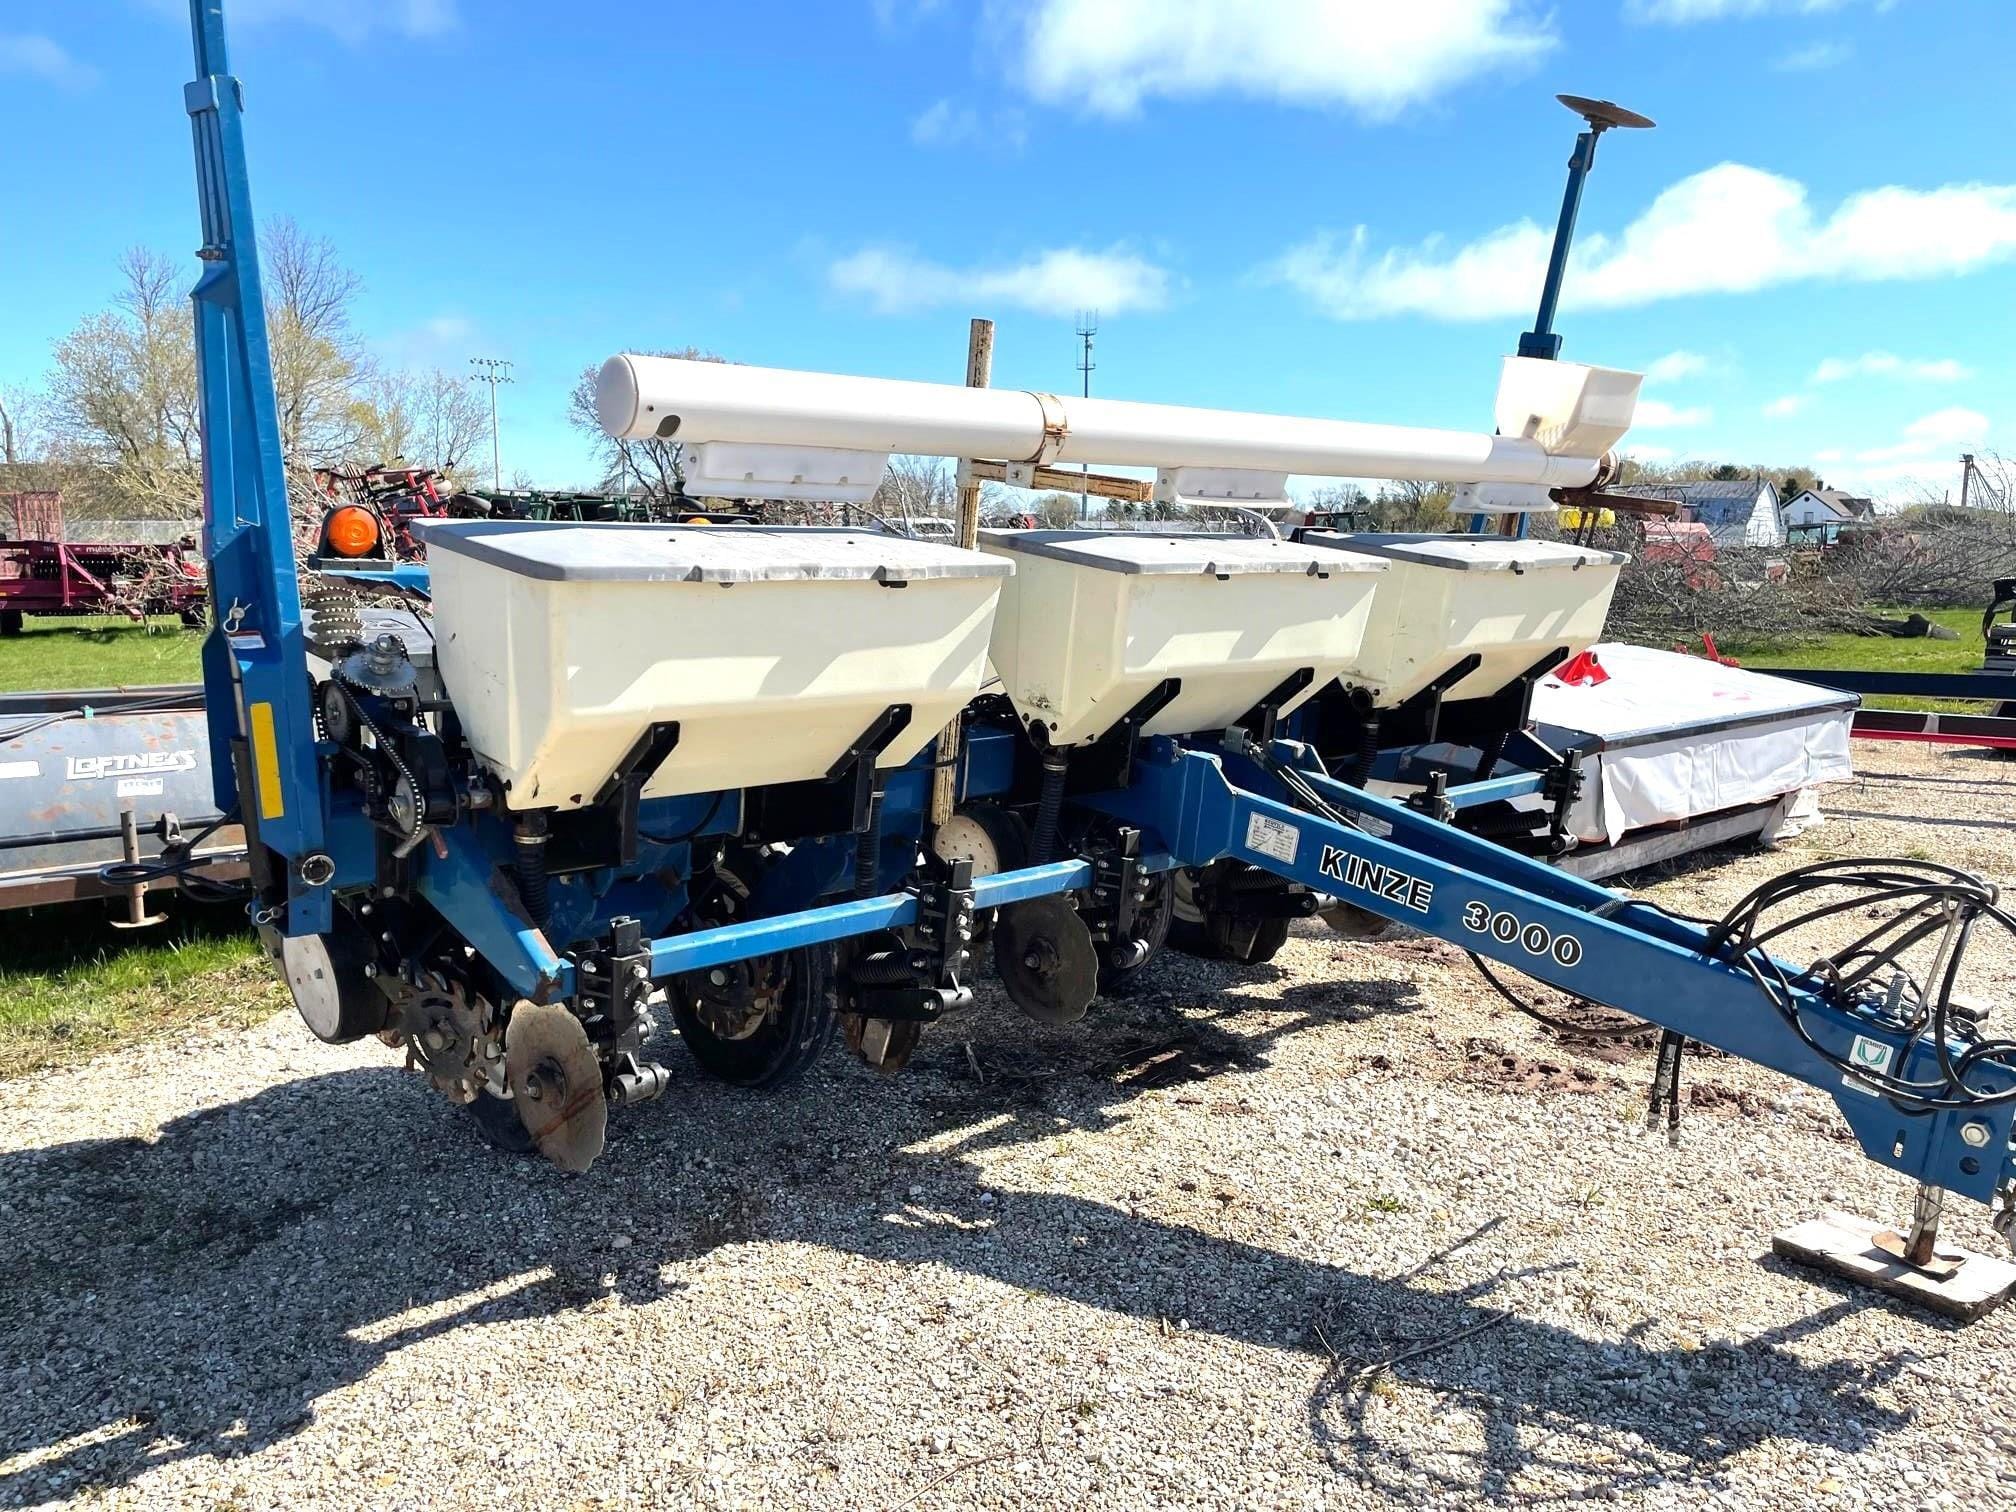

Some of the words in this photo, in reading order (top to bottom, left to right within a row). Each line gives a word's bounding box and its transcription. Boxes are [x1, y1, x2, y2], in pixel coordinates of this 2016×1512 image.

[66, 750, 196, 780] LOFTNESS
[1319, 845, 1433, 913] KINZE
[1462, 901, 1582, 966] 3000
